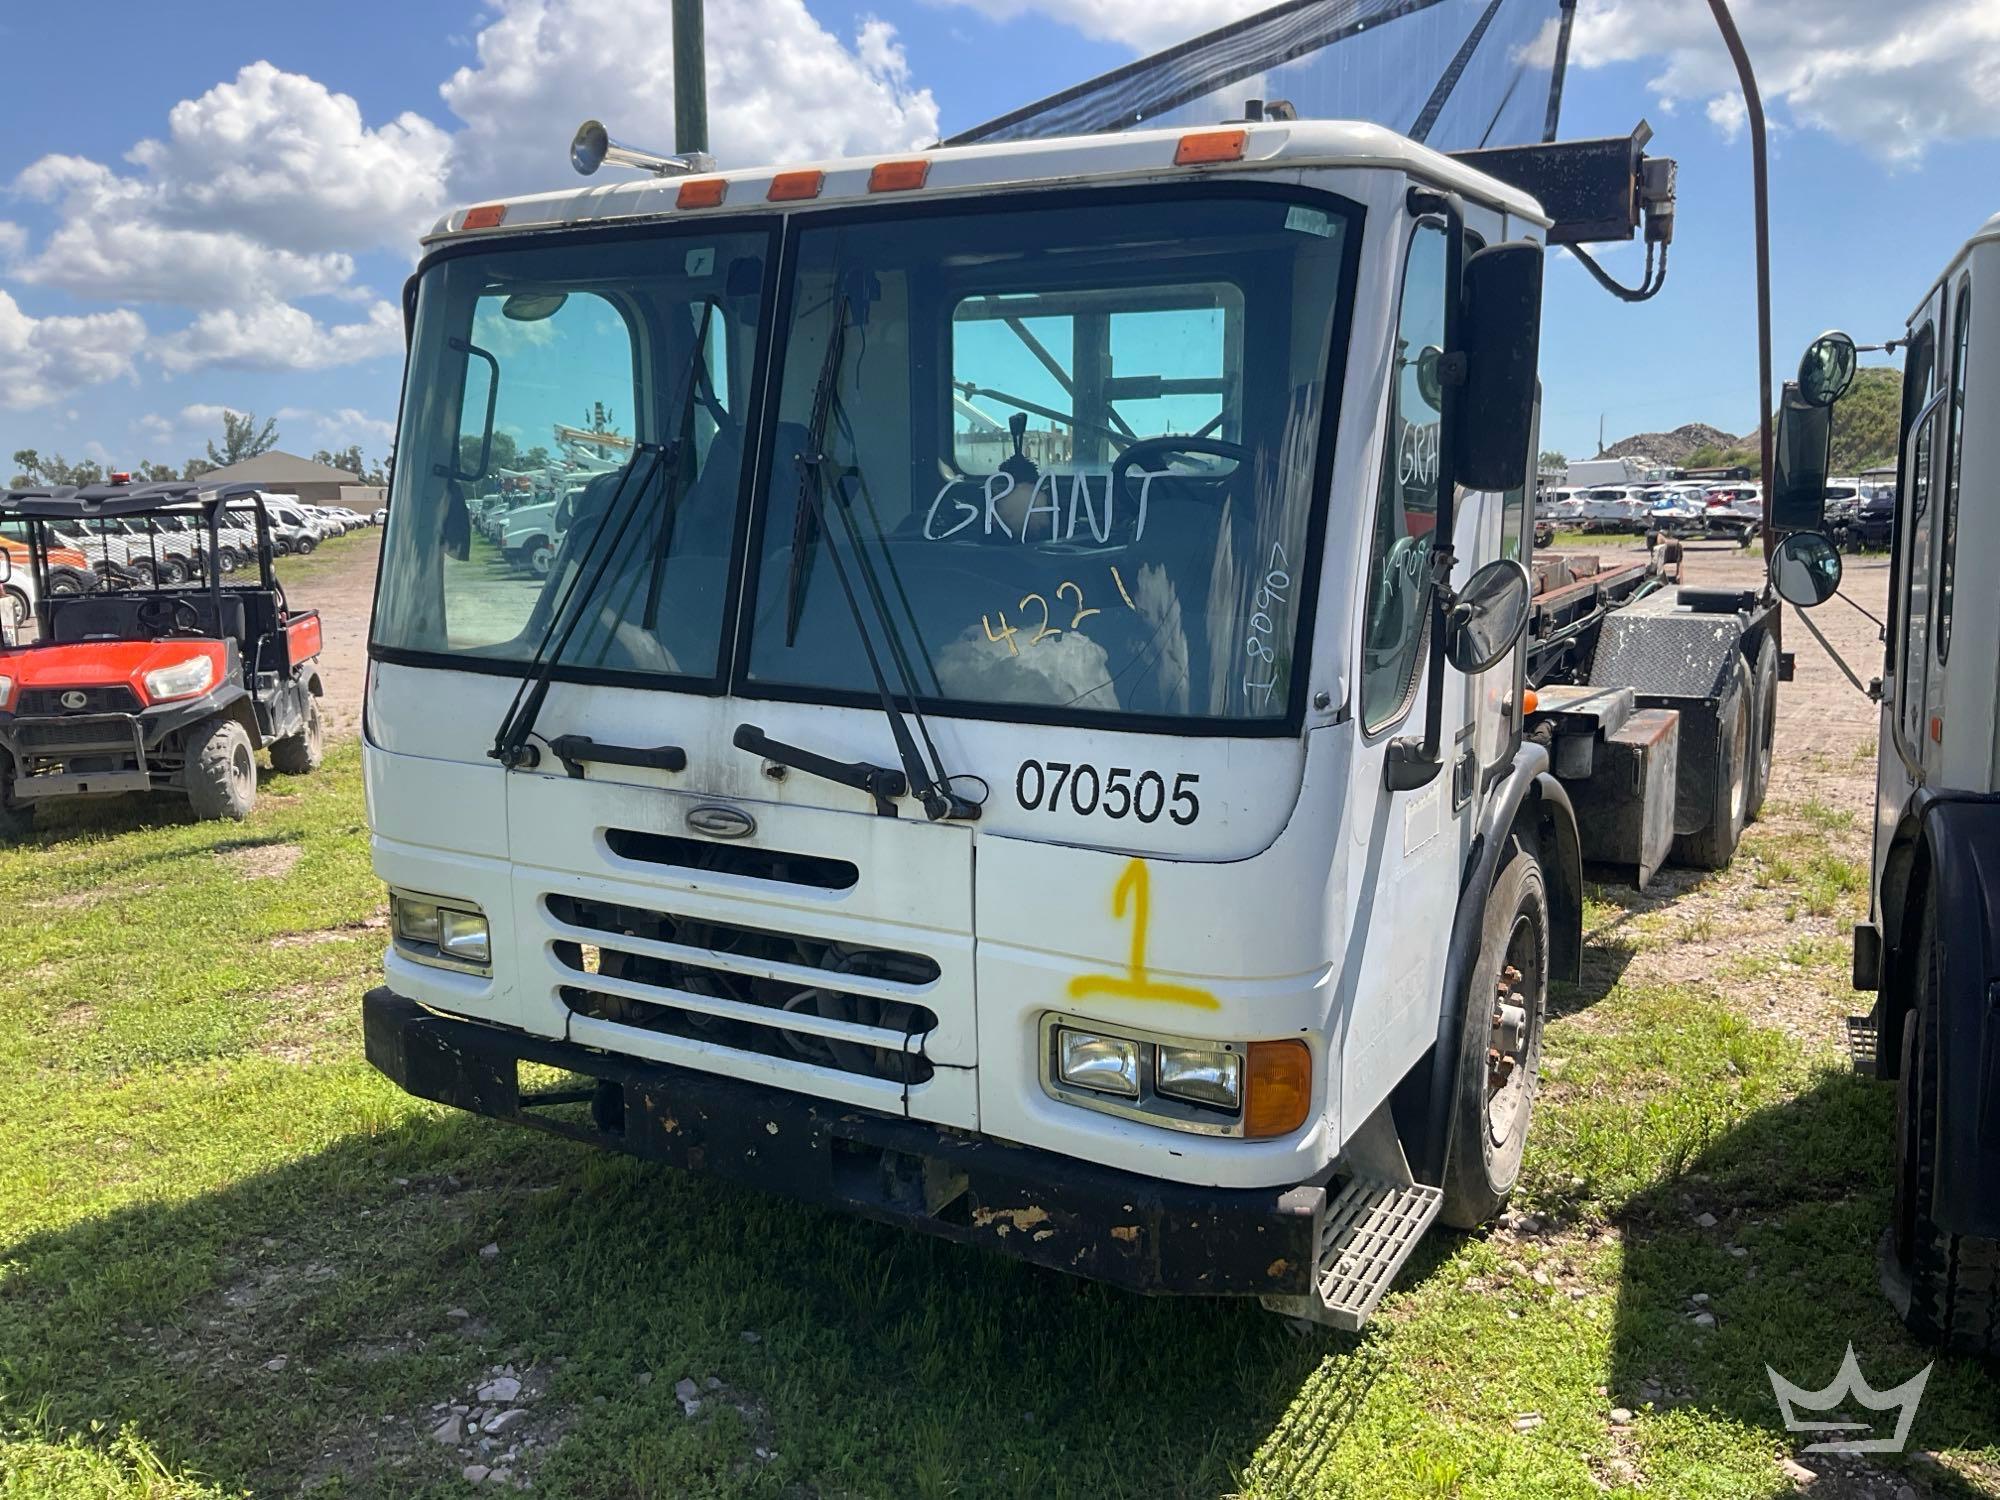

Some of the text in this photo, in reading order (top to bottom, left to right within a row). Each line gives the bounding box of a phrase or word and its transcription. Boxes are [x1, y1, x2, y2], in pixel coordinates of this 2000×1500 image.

[922, 469, 1187, 544] GRANT
[1015, 758, 1201, 826] 070505
[1066, 856, 1222, 1011] 1
